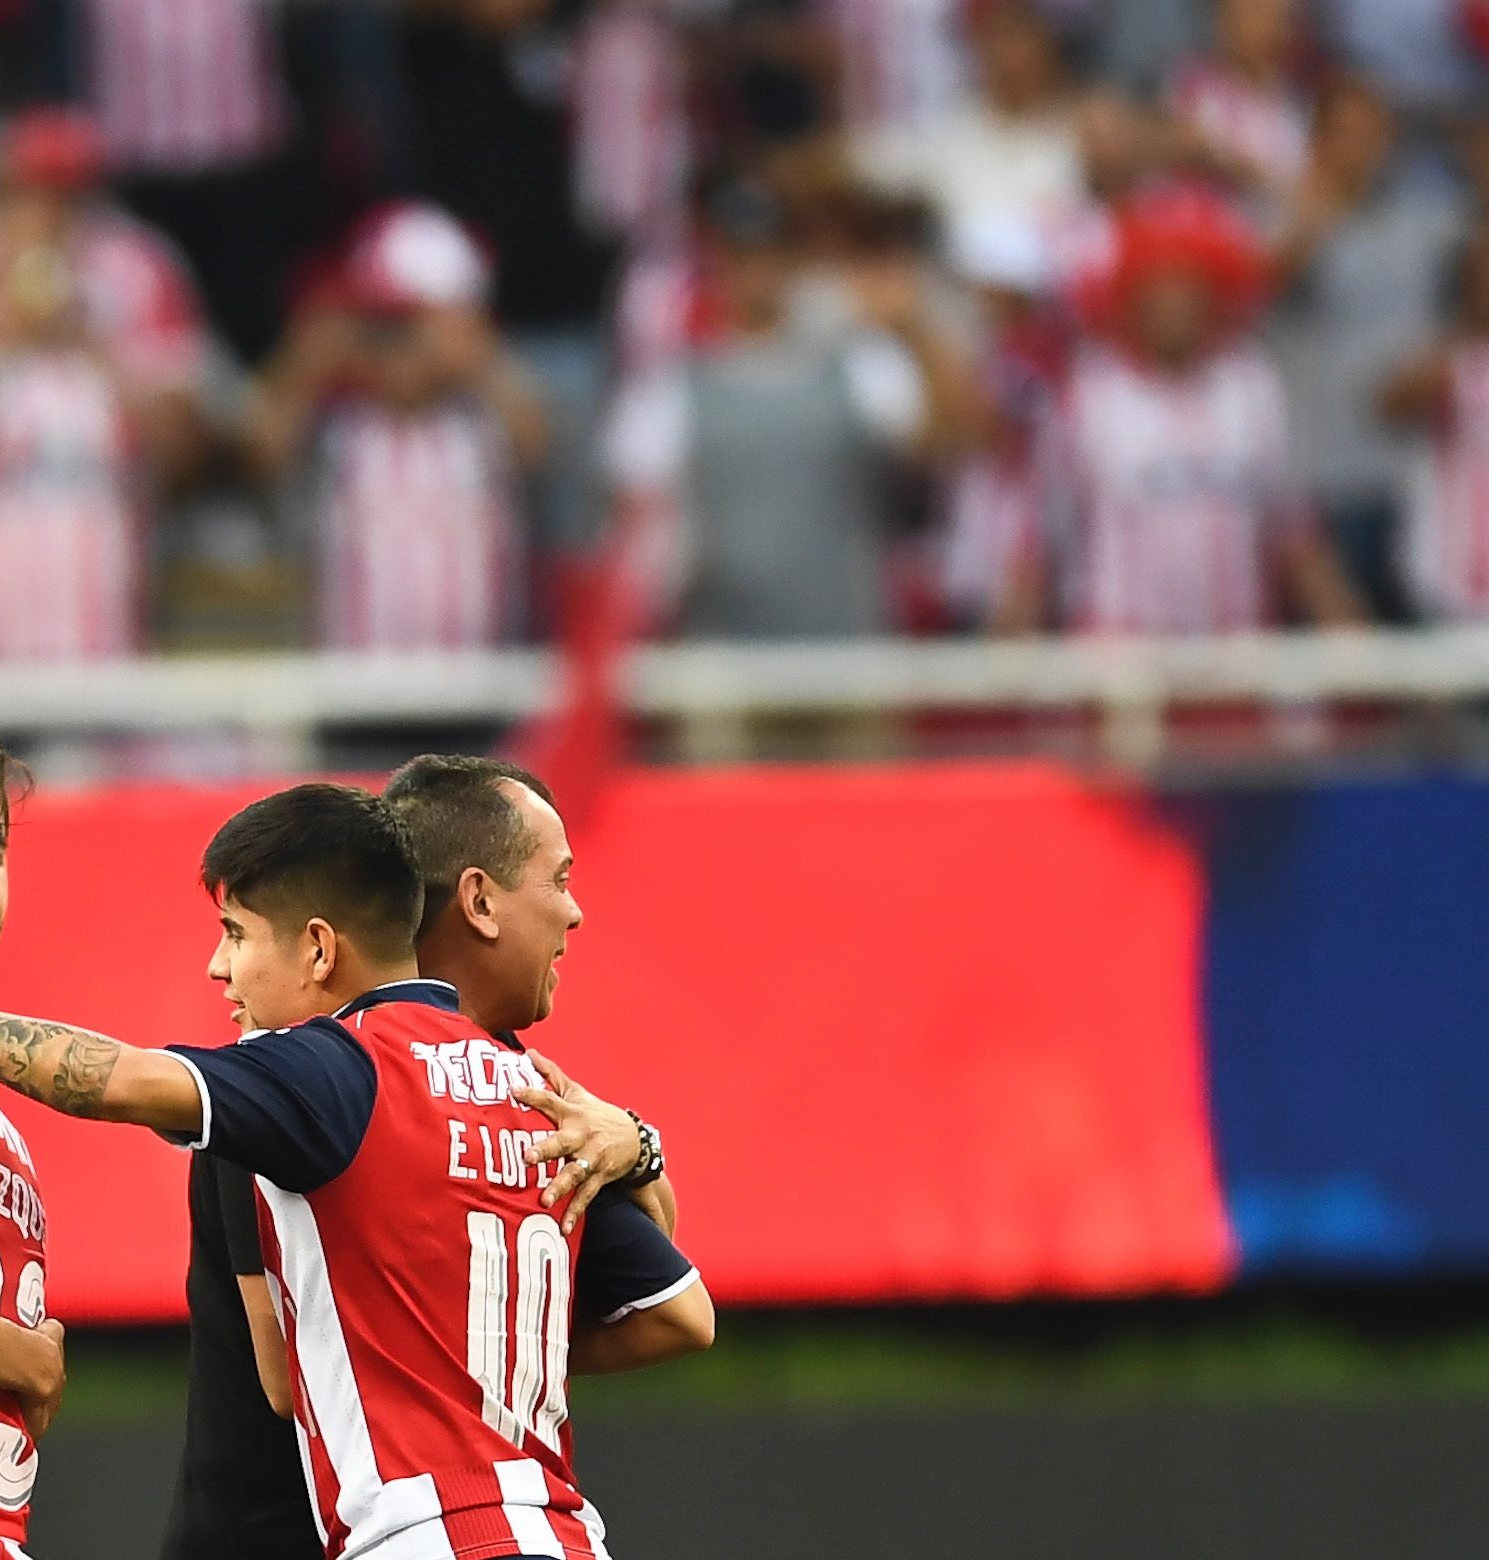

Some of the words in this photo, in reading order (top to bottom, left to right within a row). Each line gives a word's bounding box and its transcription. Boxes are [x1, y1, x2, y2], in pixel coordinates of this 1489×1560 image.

[409, 1039, 547, 1112] TECAT
[448, 1119, 478, 1180] E.
[478, 1125, 566, 1189] LOPE
[465, 1210, 572, 1457] 10
